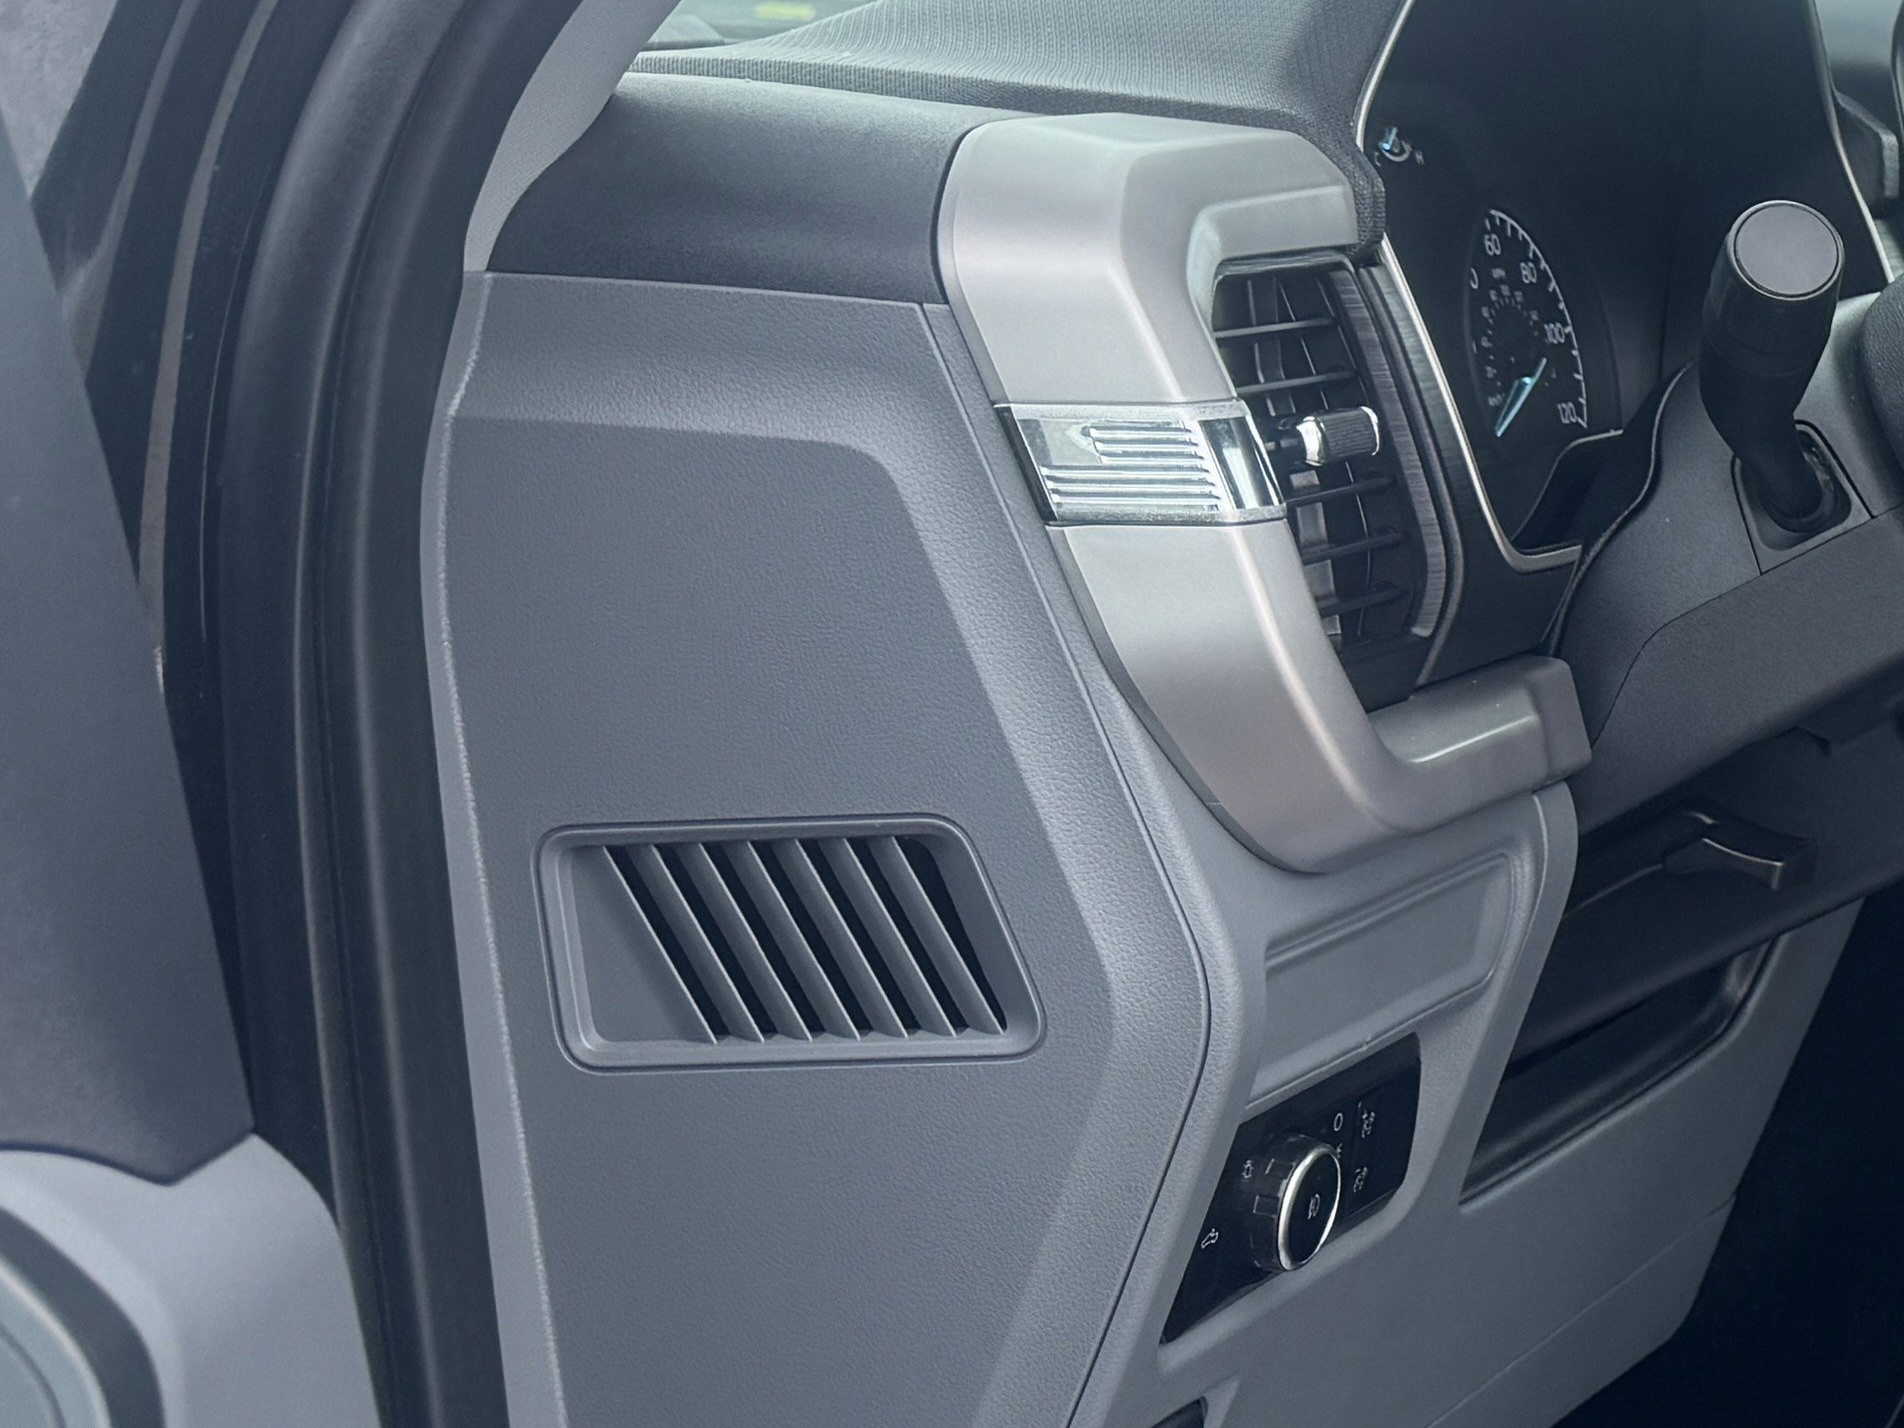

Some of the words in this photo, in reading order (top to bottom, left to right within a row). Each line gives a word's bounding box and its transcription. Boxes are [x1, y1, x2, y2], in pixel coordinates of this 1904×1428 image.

[1483, 233, 1502, 256] 60
[1520, 261, 1537, 284] 80
[1544, 322, 1566, 345] 100
[1557, 401, 1578, 425] 120
